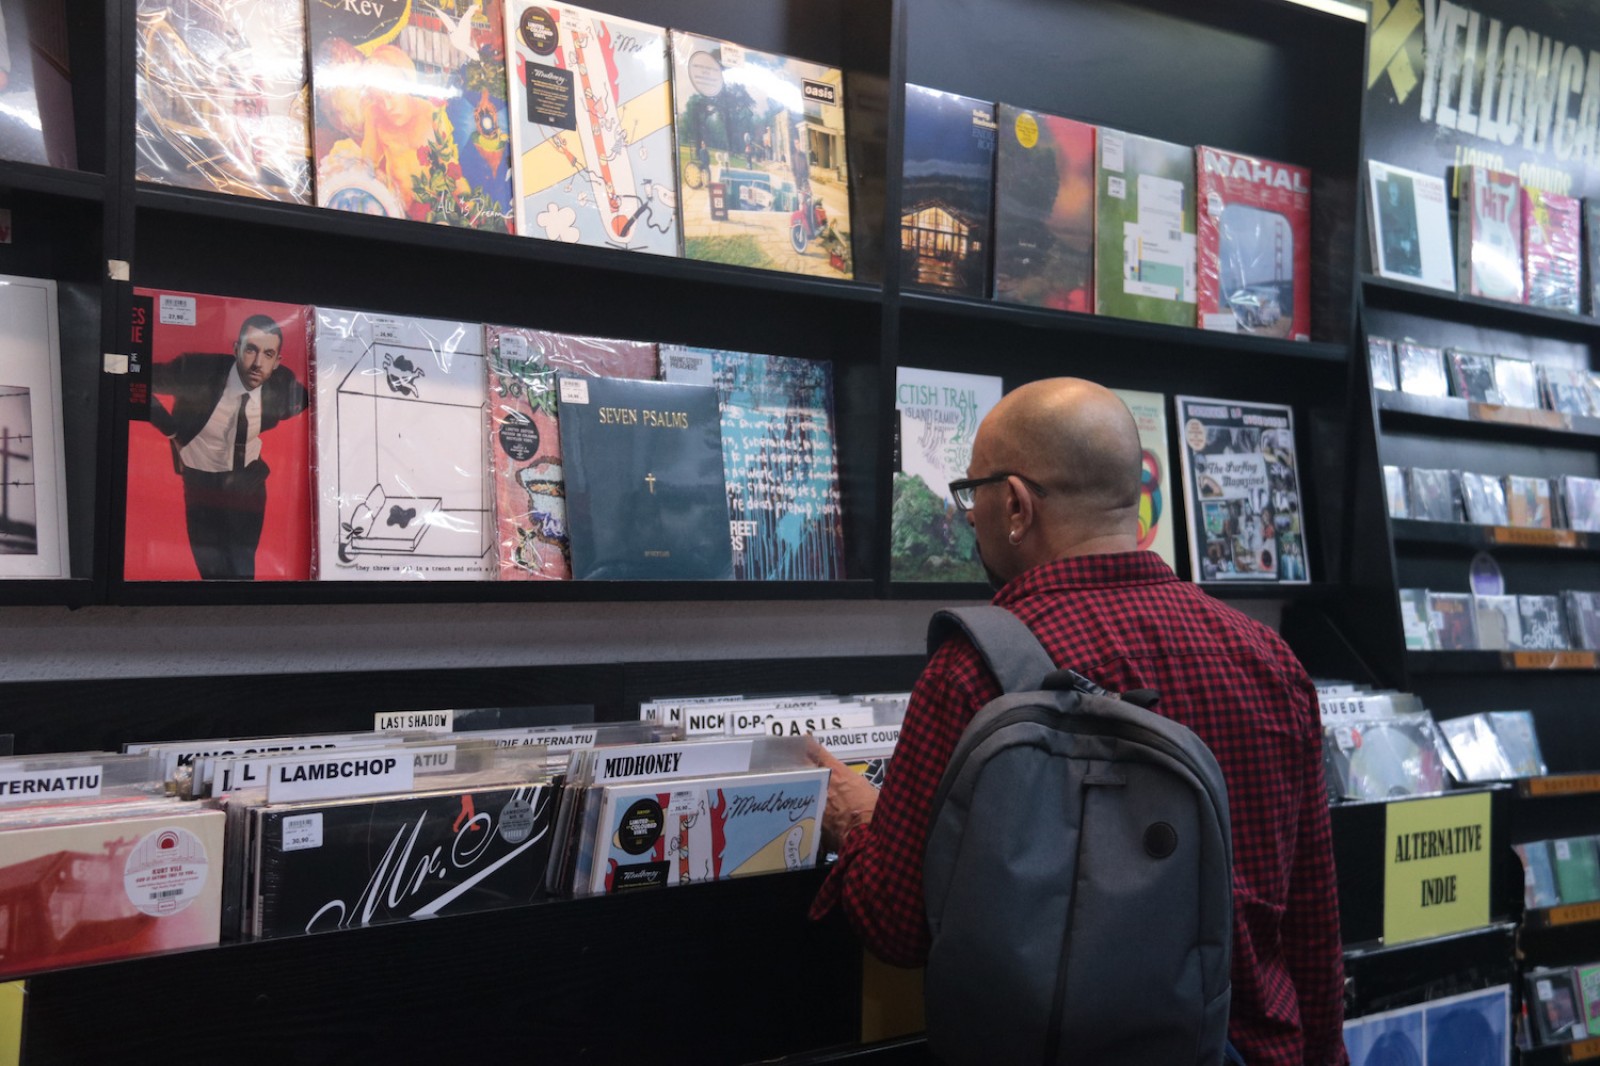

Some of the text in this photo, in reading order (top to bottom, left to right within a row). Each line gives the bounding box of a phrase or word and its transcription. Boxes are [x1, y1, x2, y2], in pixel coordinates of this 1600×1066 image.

[344, 0, 384, 18] Rev
[805, 86, 833, 100] oasis
[599, 407, 689, 430] SEVEN PSALMS
[730, 520, 758, 537] REET
[646, 709, 656, 720] M
[670, 708, 680, 721] N
[1320, 701, 1366, 715] SUEDE
[381, 714, 447, 730] LAST SHADOW
[772, 717, 842, 737] OASIS
[819, 732, 868, 747] PARQUET
[243, 763, 256, 782] L
[280, 758, 397, 783] LAMBCHOP
[603, 751, 683, 779] MUDHONEY
[0, 774, 100, 796] TERNATIU
[729, 790, 815, 822] Mudhoney
[1394, 824, 1483, 864] ALTERNATIVE
[1421, 874, 1457, 908] INDIE
